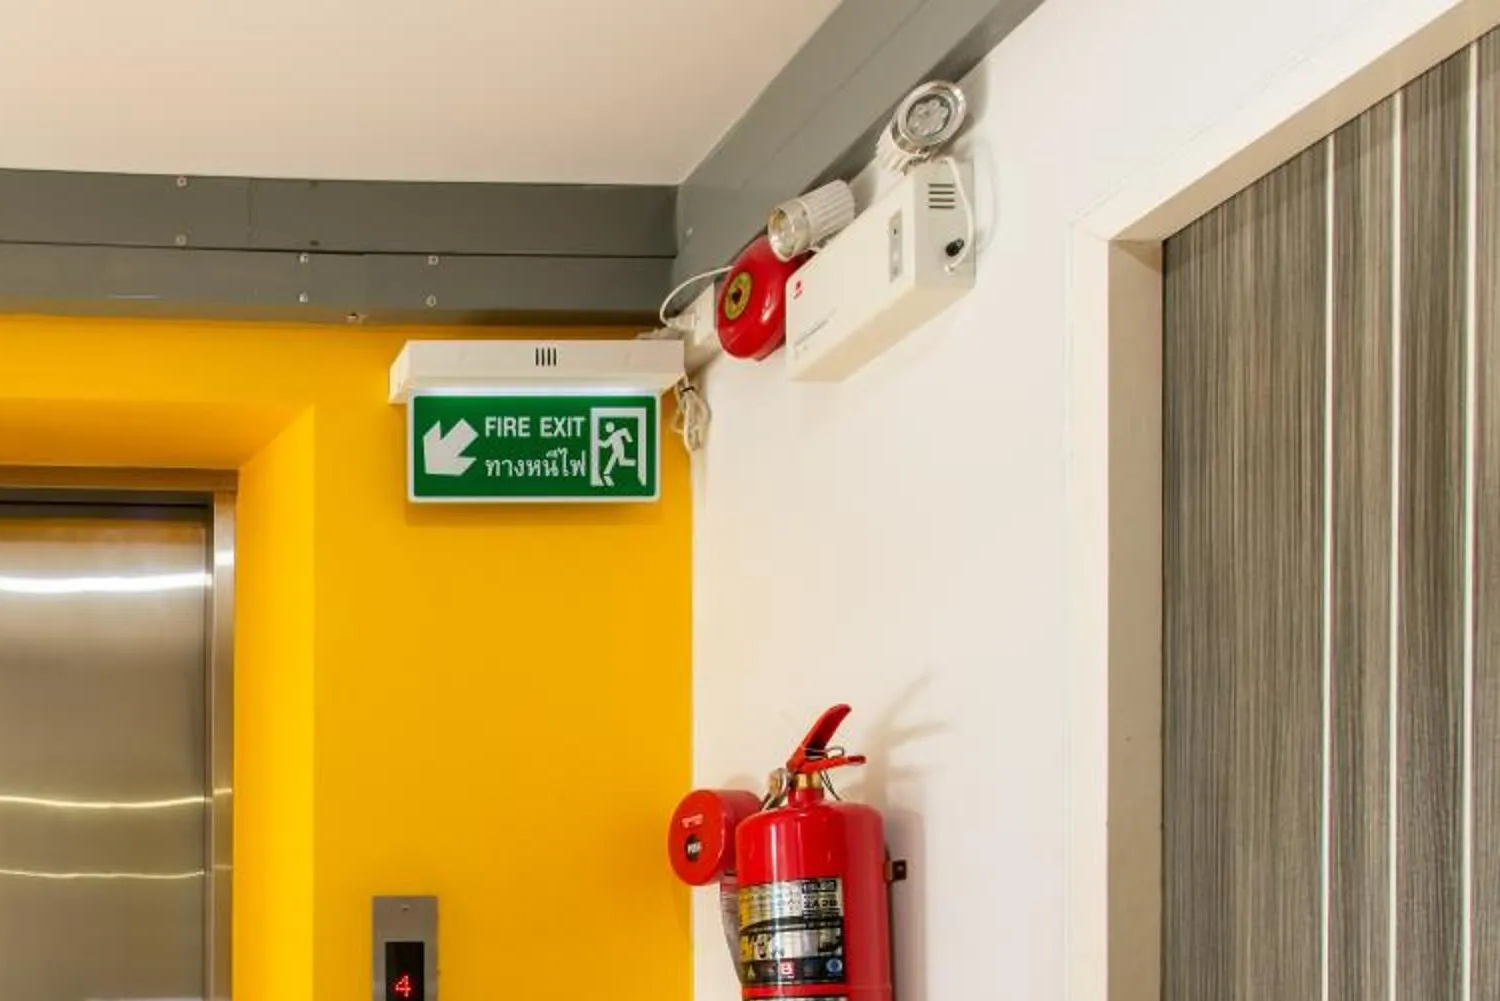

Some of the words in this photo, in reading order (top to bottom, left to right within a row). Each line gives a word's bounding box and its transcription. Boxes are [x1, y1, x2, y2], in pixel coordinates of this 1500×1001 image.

[484, 416, 531, 438] FIRE
[539, 416, 587, 438] EXIT
[484, 446, 588, 478] ทางหนีไฟ
[394, 974, 412, 998] 4
